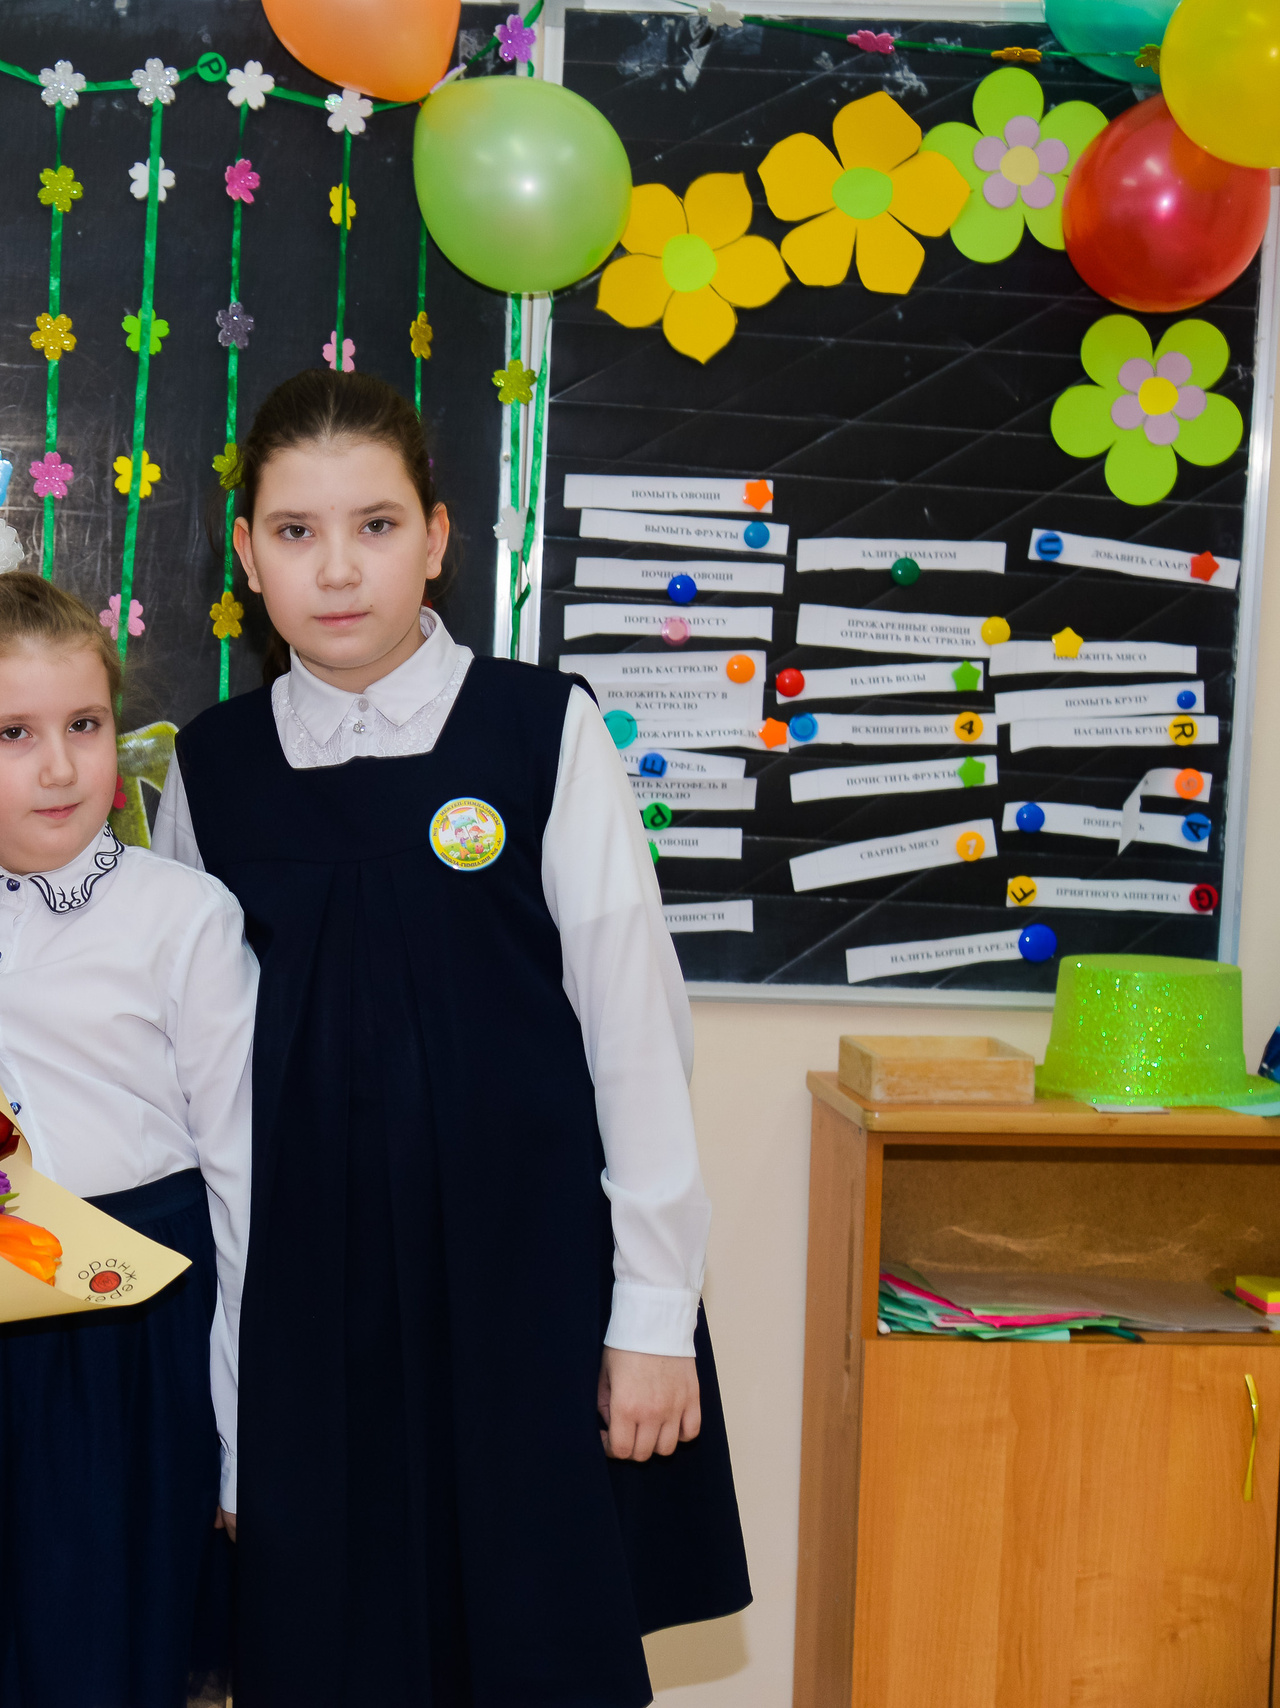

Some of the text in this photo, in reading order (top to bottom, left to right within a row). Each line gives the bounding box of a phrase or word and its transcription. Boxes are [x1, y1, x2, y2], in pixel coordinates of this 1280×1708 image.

[631, 490, 721, 501] ПОМЫТЬ ОВОЩИ
[644, 524, 739, 540] ВЫМЫТЬ ФРУКТЫ
[861, 550, 957, 560] ЗАЛИТЬ ТОМАТОМ
[693, 573, 733, 581] ОВОЩИ
[847, 619, 970, 635] ПРОЖАРЕННЫЕ ОВОЩИ
[840, 630, 902, 642] ОТПРАВИТЬ
[913, 635, 976, 646] КАСТРЮЛЮ
[1116, 653, 1147, 661] МЯСО
[622, 665, 718, 675] ВЗЯТЬ КАСТРЮЛЮ
[850, 674, 926, 686] НАЛИТЬ ВОДЫ
[608, 690, 667, 699] ПОЛОЖИТЬ
[669, 690, 719, 700] КАПУСТУ
[635, 702, 698, 710] КАСТРЮЛЮ
[1065, 695, 1149, 708] ПОМЫТЬ КРУПУ
[637, 729, 758, 739] ПОЖАРИТЬ КАРТОФЕЛЬ
[851, 726, 951, 735] ВСКИПЯТИТЬ ВОДУ
[1074, 726, 1169, 736] НАСЫПАТЬ КРУПУ
[1173, 722, 1195, 740] R
[846, 769, 958, 786] ПОЧИСТИТЬ ФРУКТЫ
[655, 781, 718, 789] КАРТОФЕЛЬ
[636, 792, 691, 800] АСТРЮЛЮ
[659, 838, 699, 847] ОВОЩИ
[860, 838, 939, 860] СВАРИТЬ МЯСО
[1056, 887, 1181, 902] ПРИЯТНОГО АППЕТИТА!
[891, 950, 933, 964] НАЛИТЬ
[935, 947, 965, 958] БОРЩ
[977, 941, 1017, 953] ТАРЕЛК
